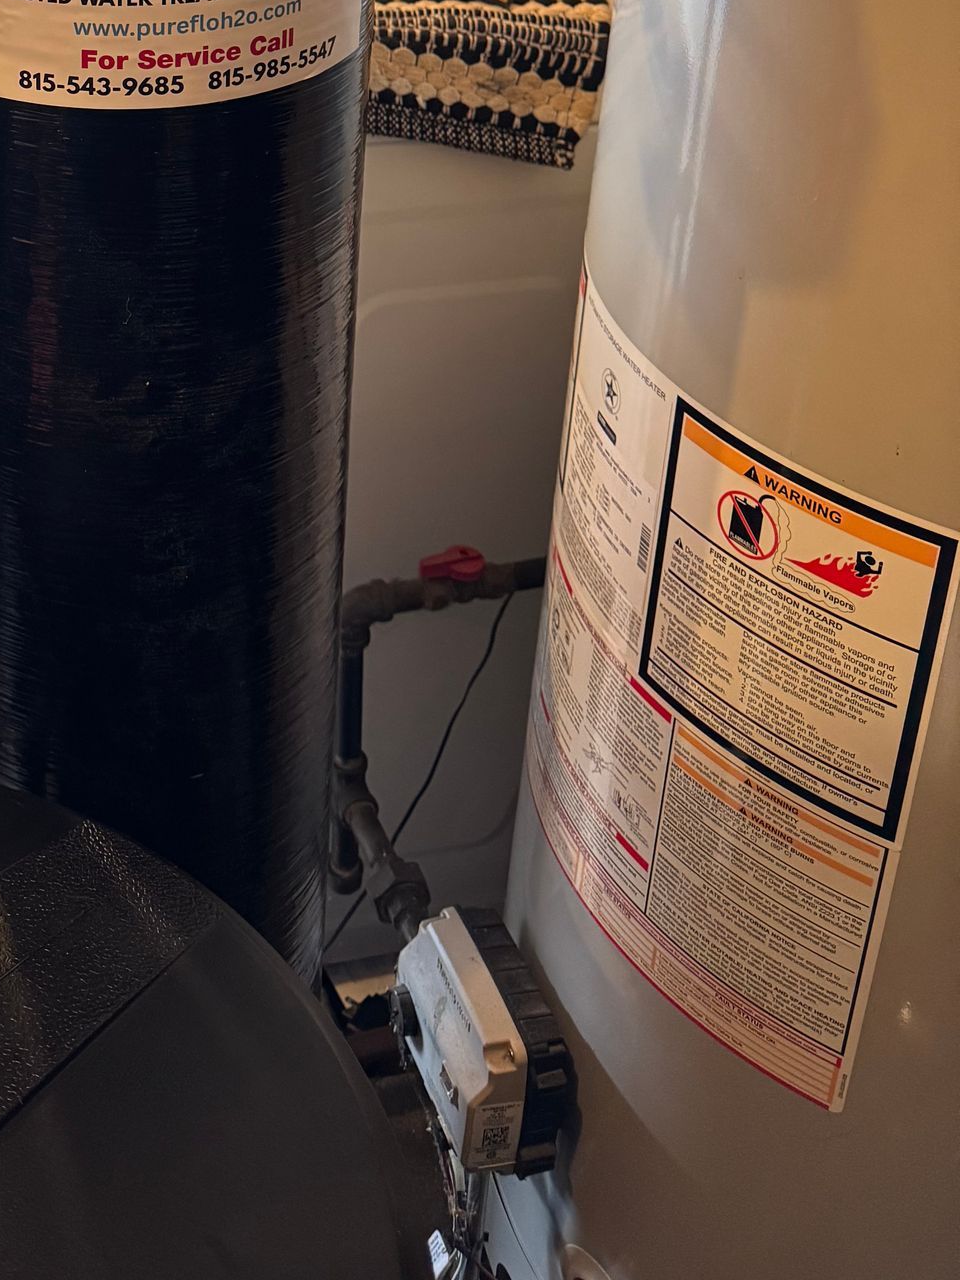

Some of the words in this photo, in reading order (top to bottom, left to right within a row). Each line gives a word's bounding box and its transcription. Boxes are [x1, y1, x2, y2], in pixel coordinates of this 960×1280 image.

[19, 70, 184, 96] 815-543-9685
[208, 35, 336, 90] 815-985-5547
[81, 48, 129, 70] For
[138, 41, 242, 69] Service
[249, 27, 294, 57] Call
[623, 351, 641, 377] WATER
[641, 372, 666, 401] HEATER
[764, 474, 842, 525] WARNING
[684, 544, 693, 557] Do
[694, 553, 704, 565] not
[705, 561, 720, 577] store
[721, 573, 728, 583] or
[729, 579, 742, 592] use
[743, 587, 772, 612] gasoline
[773, 607, 781, 617] or
[783, 611, 802, 628] other
[804, 623, 845, 650] flammable
[847, 646, 875, 665] vapors
[877, 659, 894, 672] and
[709, 546, 727, 565] FIRE
[728, 559, 746, 577] AND
[748, 572, 799, 609] EXPLOSION
[801, 604, 842, 631] HAZARD
[712, 557, 725, 573] Can
[746, 580, 753, 590] in
[753, 585, 779, 607] serious
[781, 602, 801, 620] injury
[803, 615, 811, 624] or
[813, 619, 835, 637] death
[776, 565, 821, 595] Flammable
[823, 589, 854, 612] Vapors
[682, 560, 688, 570] of
[715, 586, 722, 596] or
[723, 591, 739, 608] other
[778, 627, 804, 648] vapors
[805, 642, 814, 652] or
[815, 647, 841, 667] liquids
[843, 661, 851, 670] in
[853, 666, 866, 678] the
[868, 672, 898, 692] vicinity
[687, 574, 694, 583] or
[707, 588, 723, 605] other
[724, 600, 756, 629] appliance
[757, 623, 771, 636] can
[772, 632, 793, 649] result
[794, 644, 802, 654] in
[803, 649, 832, 670] serious
[833, 665, 856, 683] injury
[857, 678, 867, 687] or
[691, 559, 697, 568] in
[697, 564, 707, 576] the
[731, 588, 738, 598] of
[739, 594, 751, 607] this
[752, 603, 759, 612] or
[761, 608, 774, 622] any
[776, 616, 795, 633] other
[796, 628, 836, 656] appliance.
[841, 650, 874, 674] Storage
[876, 667, 885, 677] of
[886, 672, 896, 682] or
[683, 770, 703, 791] WATER
[703, 787, 715, 801] CAN
[761, 828, 789, 851] DEGREE
[790, 846, 814, 865] BURNS
[738, 782, 751, 796] FOR
[752, 791, 771, 809] YOUR
[772, 803, 798, 825] SAFETY
[751, 810, 793, 847] WARNING
[756, 782, 799, 818] WARNING
